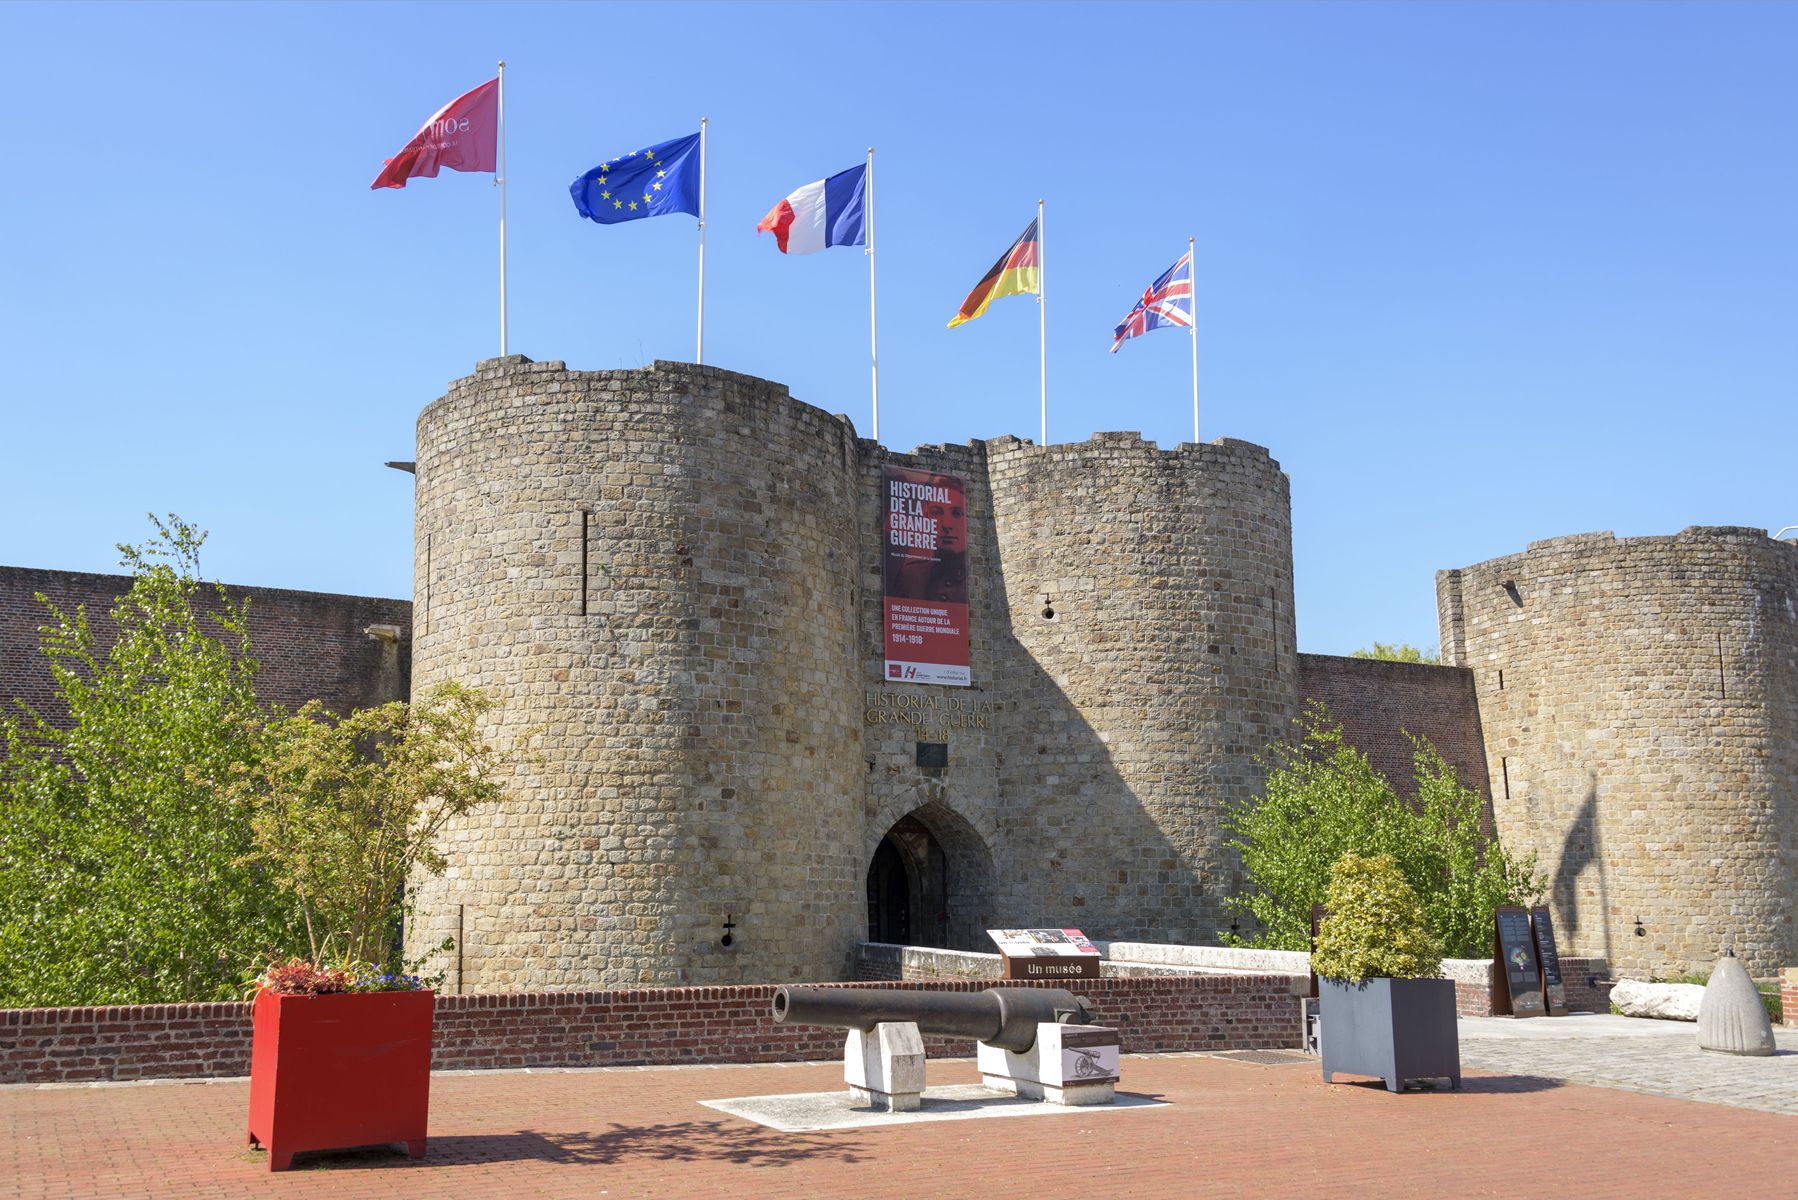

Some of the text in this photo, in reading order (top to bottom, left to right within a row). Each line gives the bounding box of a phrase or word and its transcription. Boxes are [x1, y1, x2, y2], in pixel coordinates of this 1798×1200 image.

[890, 481, 951, 504] HISTORIAL
[890, 497, 923, 516] DE LA
[890, 513, 938, 534] GRANDE
[890, 530, 937, 550] GUERRE
[892, 604, 948, 616] UNE COLLECTION UNIQUE
[892, 623, 960, 635] PREMIÈRE GUERRE MONDIALE
[899, 614, 917, 623] FRANCE
[918, 616, 936, 625] AUTOUR
[944, 618, 950, 626] LA
[892, 633, 923, 645] 1914-1918
[866, 692, 992, 712] HISTORIAL DE LA
[866, 710, 992, 729] GRANDE GUERRE
[1028, 962, 1083, 974] Un musée
